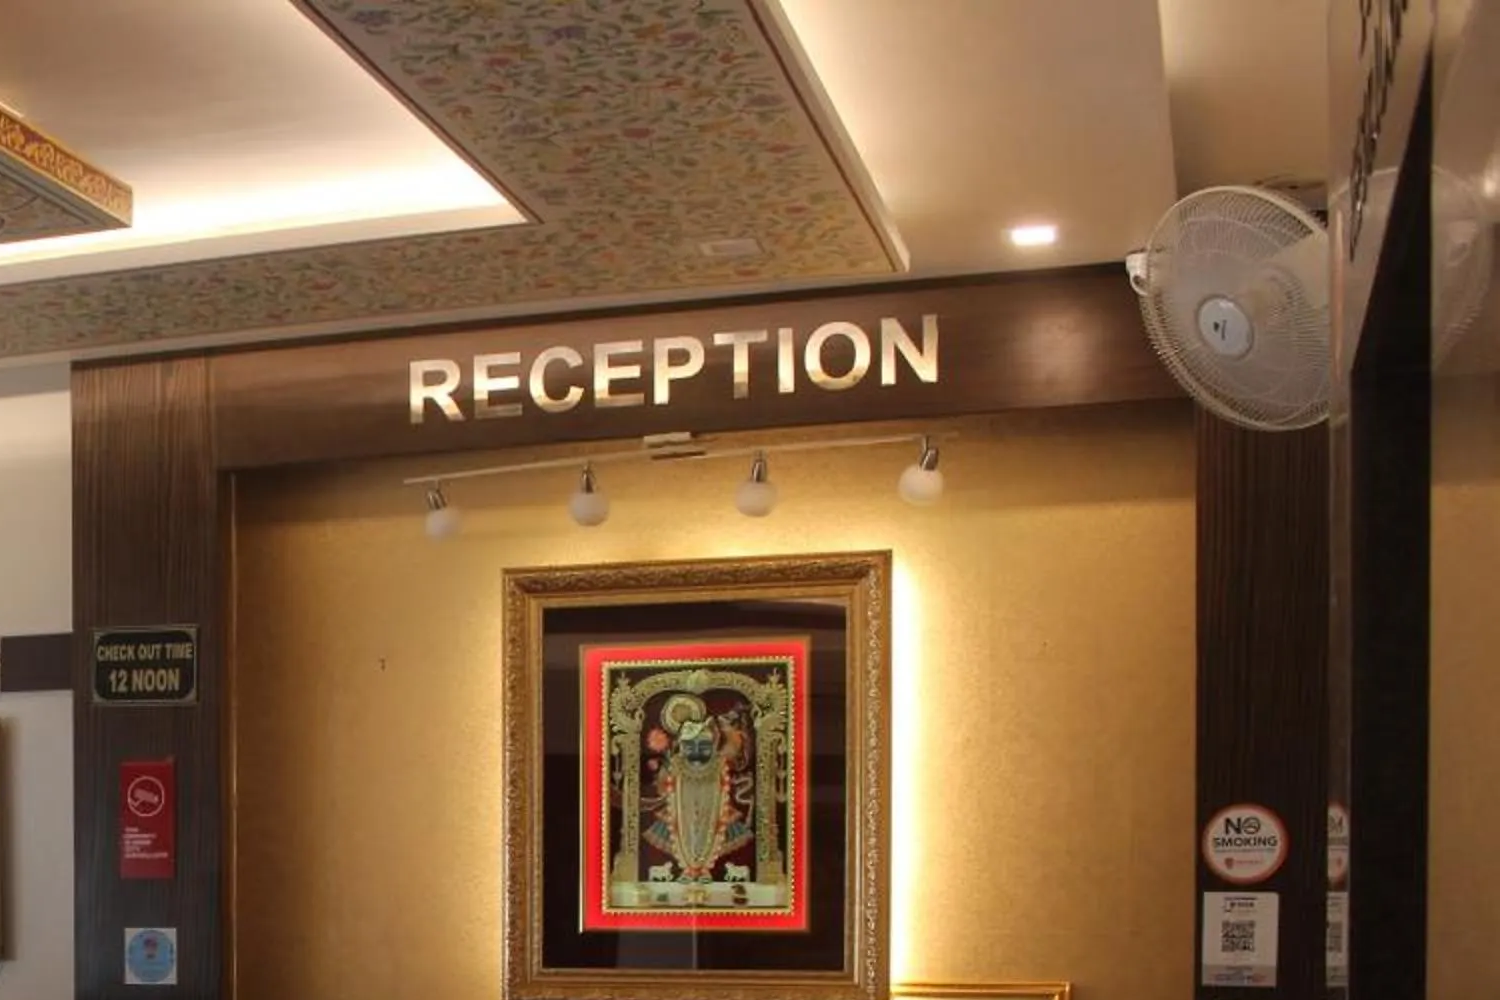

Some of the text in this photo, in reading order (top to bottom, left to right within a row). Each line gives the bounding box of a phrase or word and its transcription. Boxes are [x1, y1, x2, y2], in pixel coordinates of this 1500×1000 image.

[408, 313, 940, 425] RECEPTION
[96, 642, 193, 661] CHECK OUT TIME
[108, 668, 180, 692] 12 NOON
[1224, 815, 1261, 835] NO
[1213, 834, 1278, 847] SMOKING
